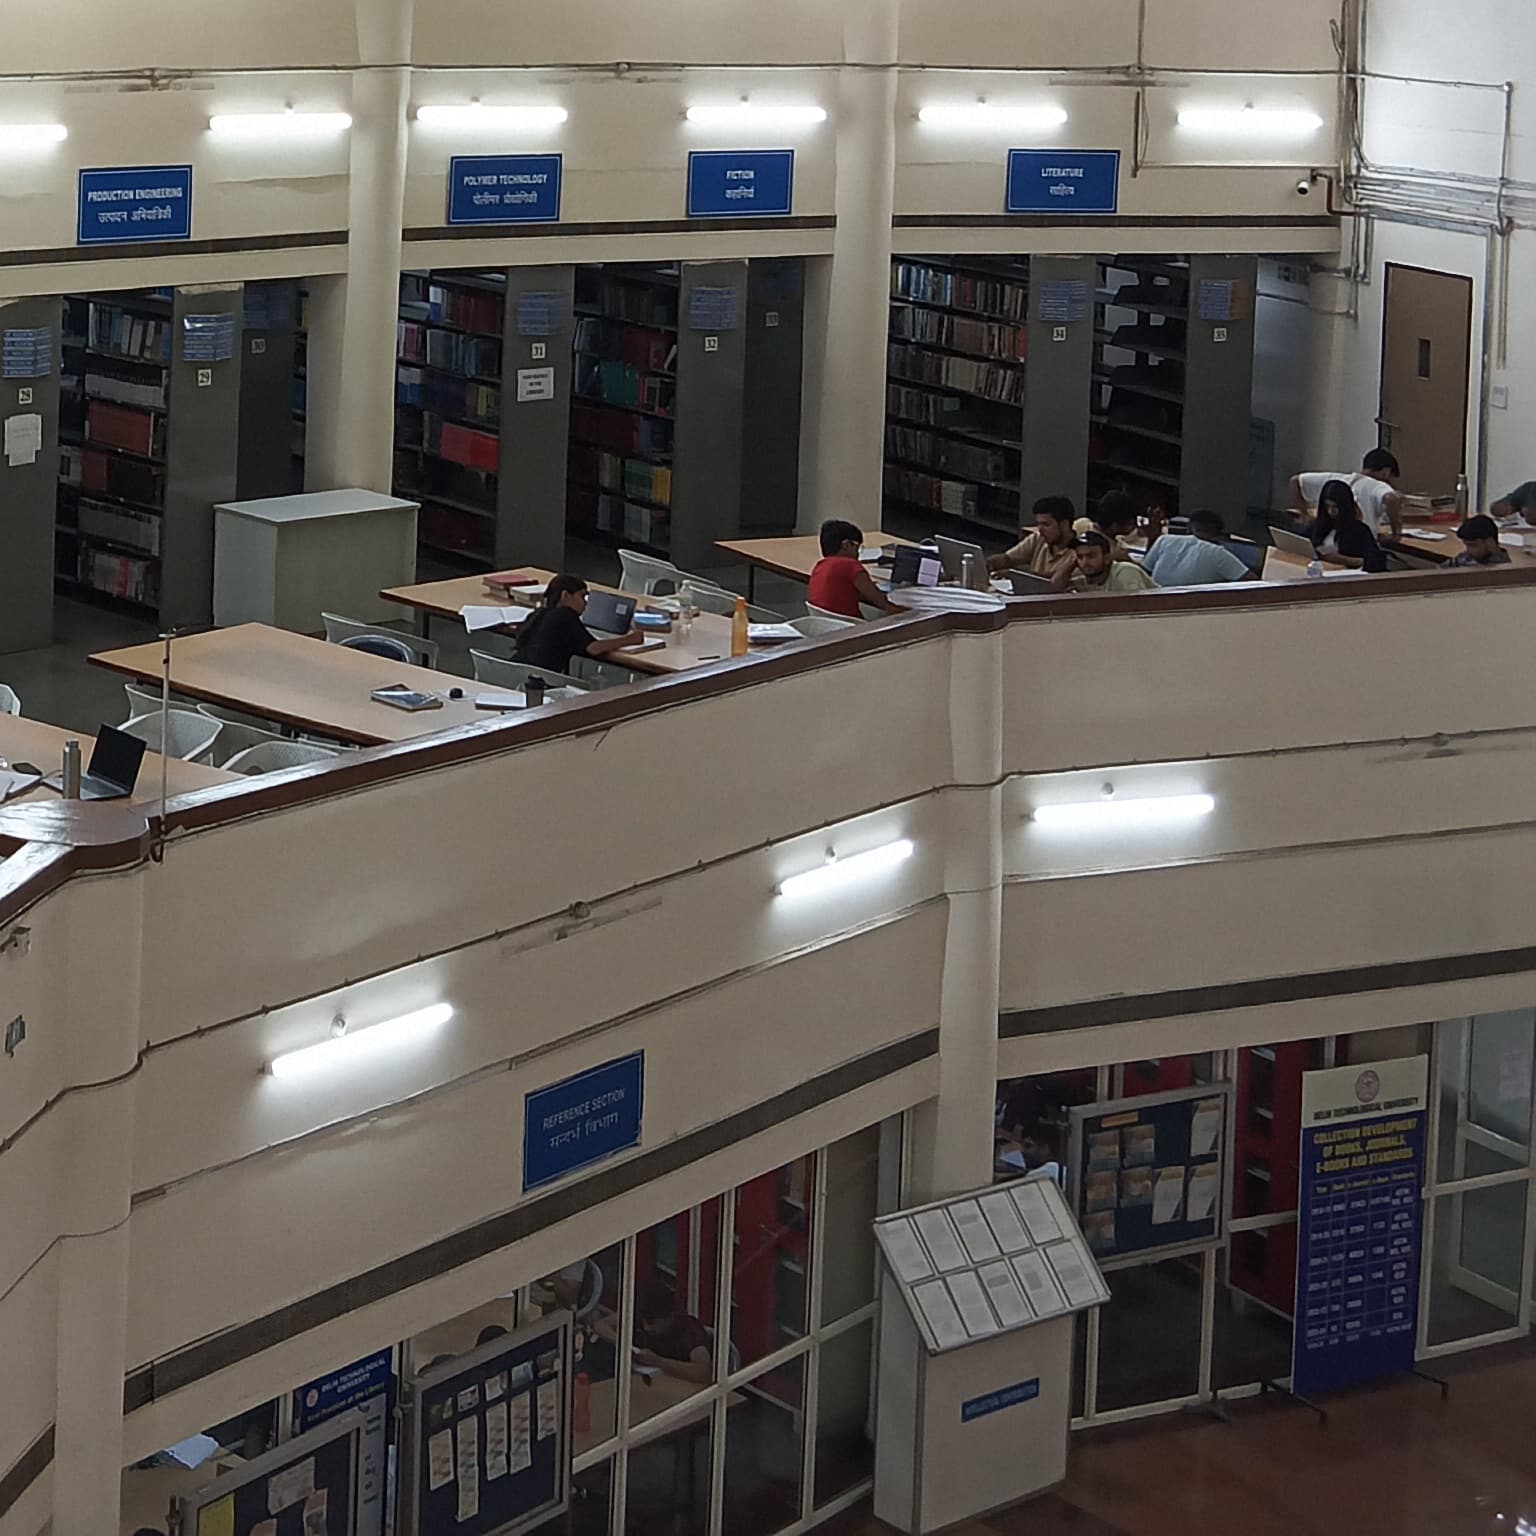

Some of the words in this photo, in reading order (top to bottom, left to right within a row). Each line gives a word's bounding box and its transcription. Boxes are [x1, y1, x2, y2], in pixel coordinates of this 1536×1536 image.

[726, 170, 754, 180] FICTION
[1041, 167, 1084, 177] LITERATURE
[464, 175, 498, 186] POLYMER
[499, 174, 548, 185] TECHNOLOGY
[87, 189, 134, 202] PRODUCTION
[135, 187, 183, 200] ENGINEERING
[199, 371, 210, 383] 29
[20, 389, 30, 402] 28
[543, 1100, 591, 1129] REFERENCE
[591, 1087, 626, 1111] SECTION
[1383, 1097, 1419, 1110] UNIVERSITY
[1313, 1127, 1361, 1145] COLLECTION
[1361, 1117, 1418, 1136] DEVELOPMENT
[1351, 1154, 1368, 1168] AND
[1369, 1147, 1414, 1165] STANDARDS
